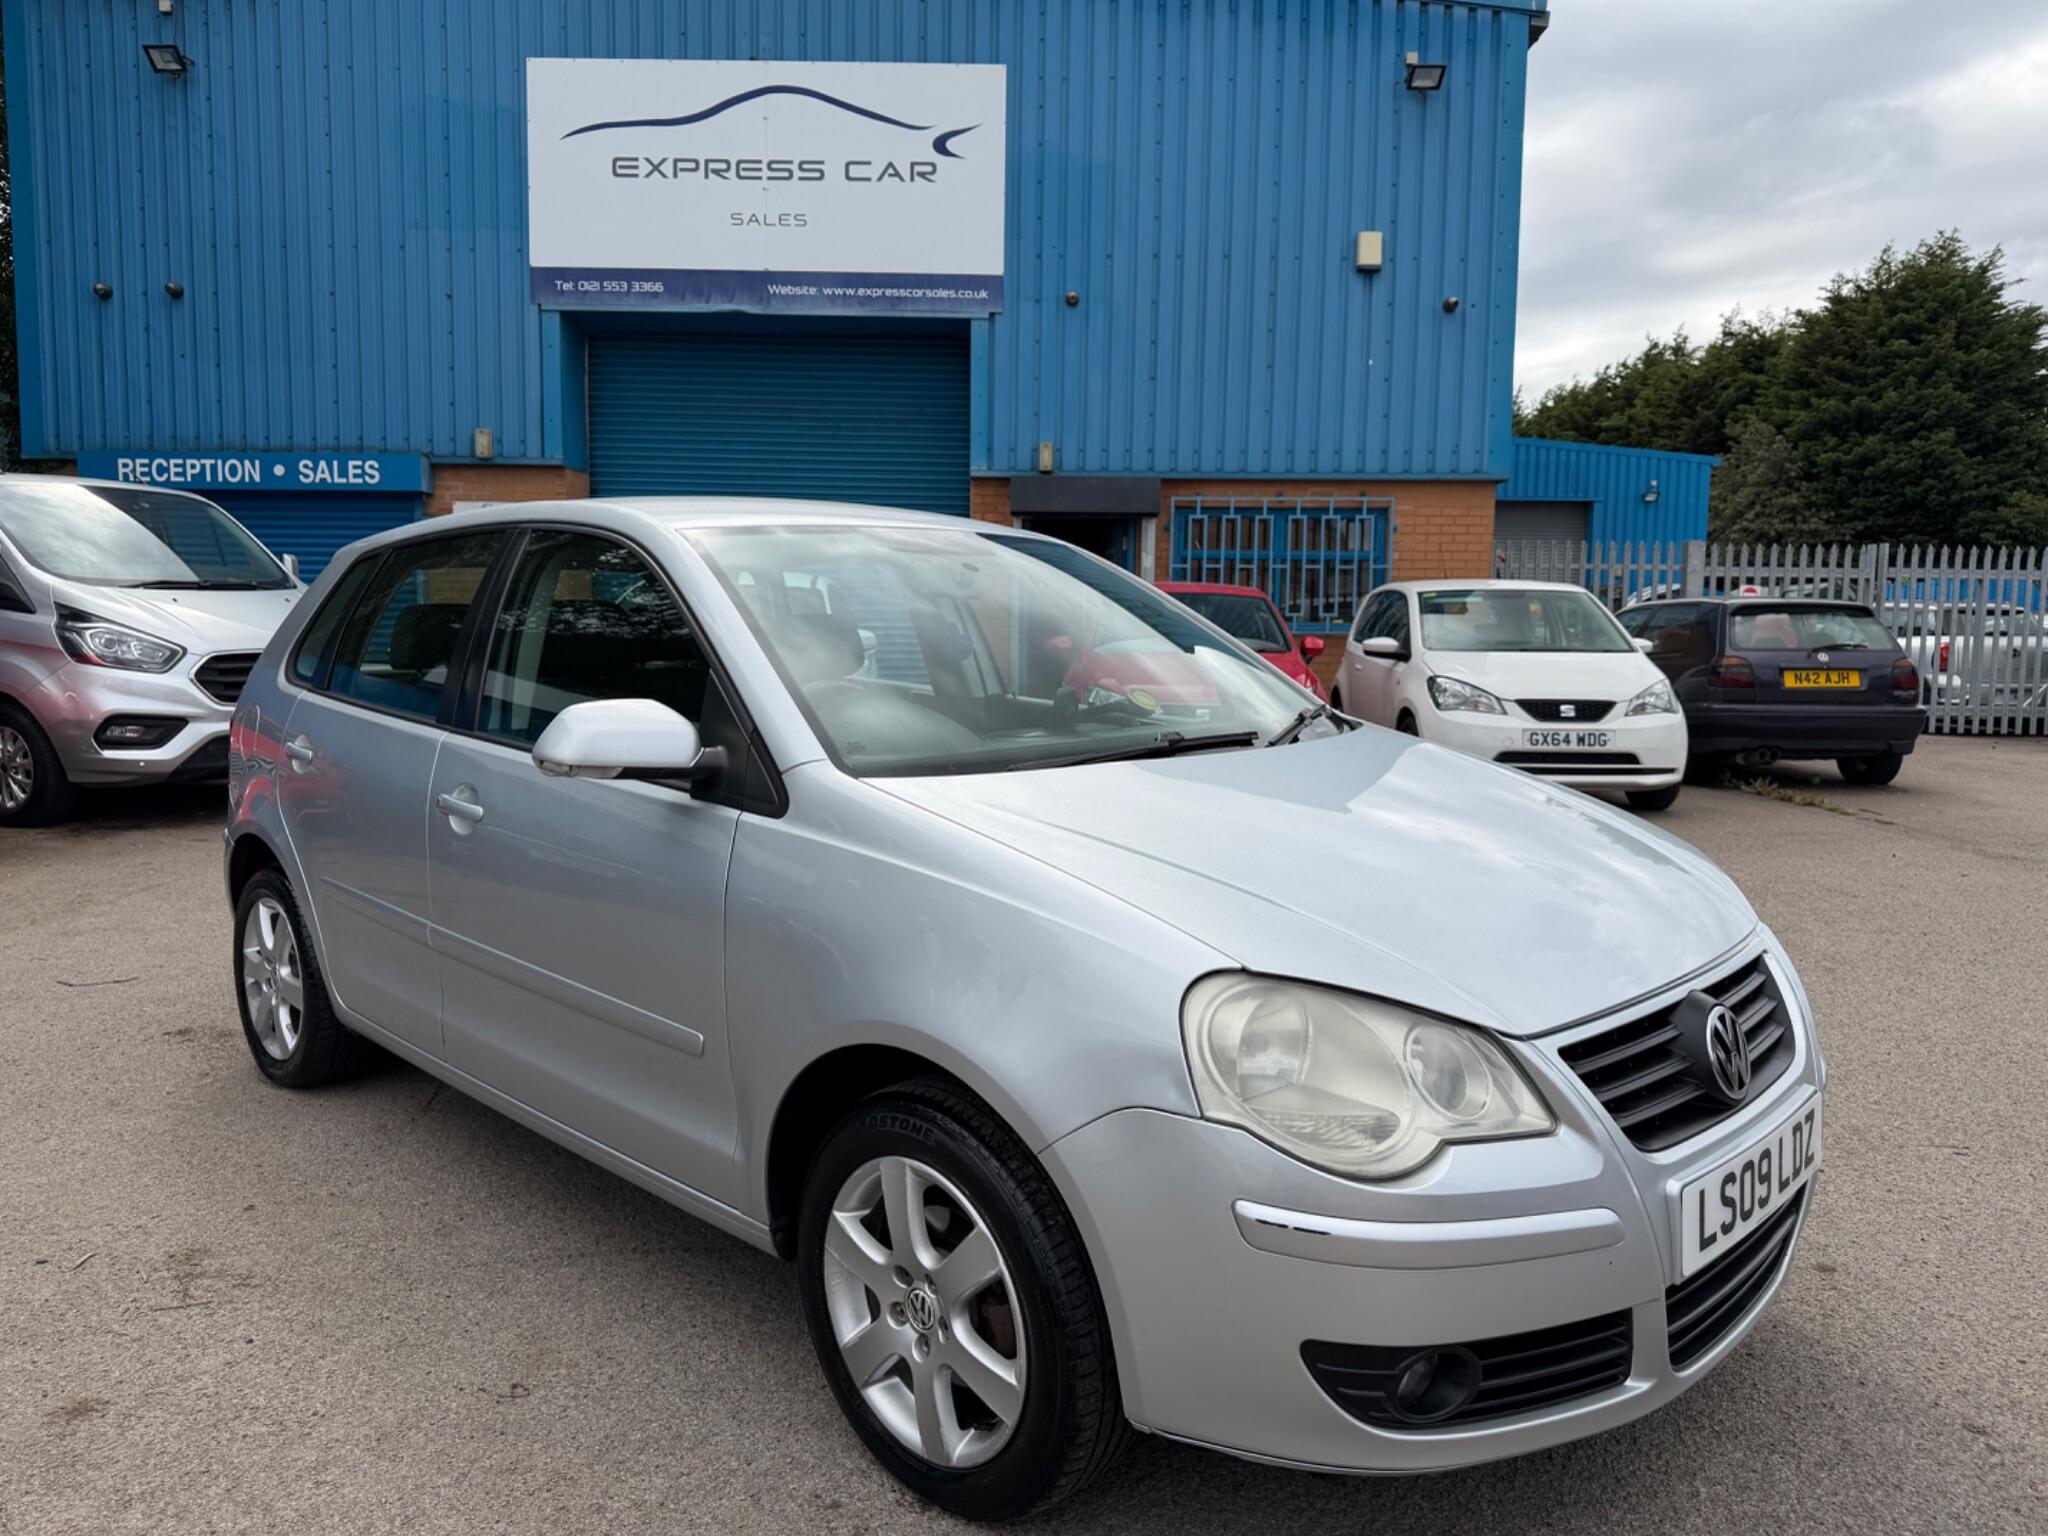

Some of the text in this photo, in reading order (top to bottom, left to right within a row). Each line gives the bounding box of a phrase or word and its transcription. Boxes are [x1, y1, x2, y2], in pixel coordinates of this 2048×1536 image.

[611, 156, 938, 183] EXPRESS CAR
[730, 212, 808, 228] SALES
[578, 280, 601, 291] 0121
[603, 281, 628, 292] 553
[631, 281, 665, 293] 3366
[767, 284, 989, 299] Website: www.expresscarsales.co.uk
[117, 457, 381, 485] RECEPTION SALES
[1793, 671, 1850, 685] N42 AJH
[1529, 732, 1608, 748] GX64 WDG
[1698, 1107, 1816, 1254] LS09 LDZ
